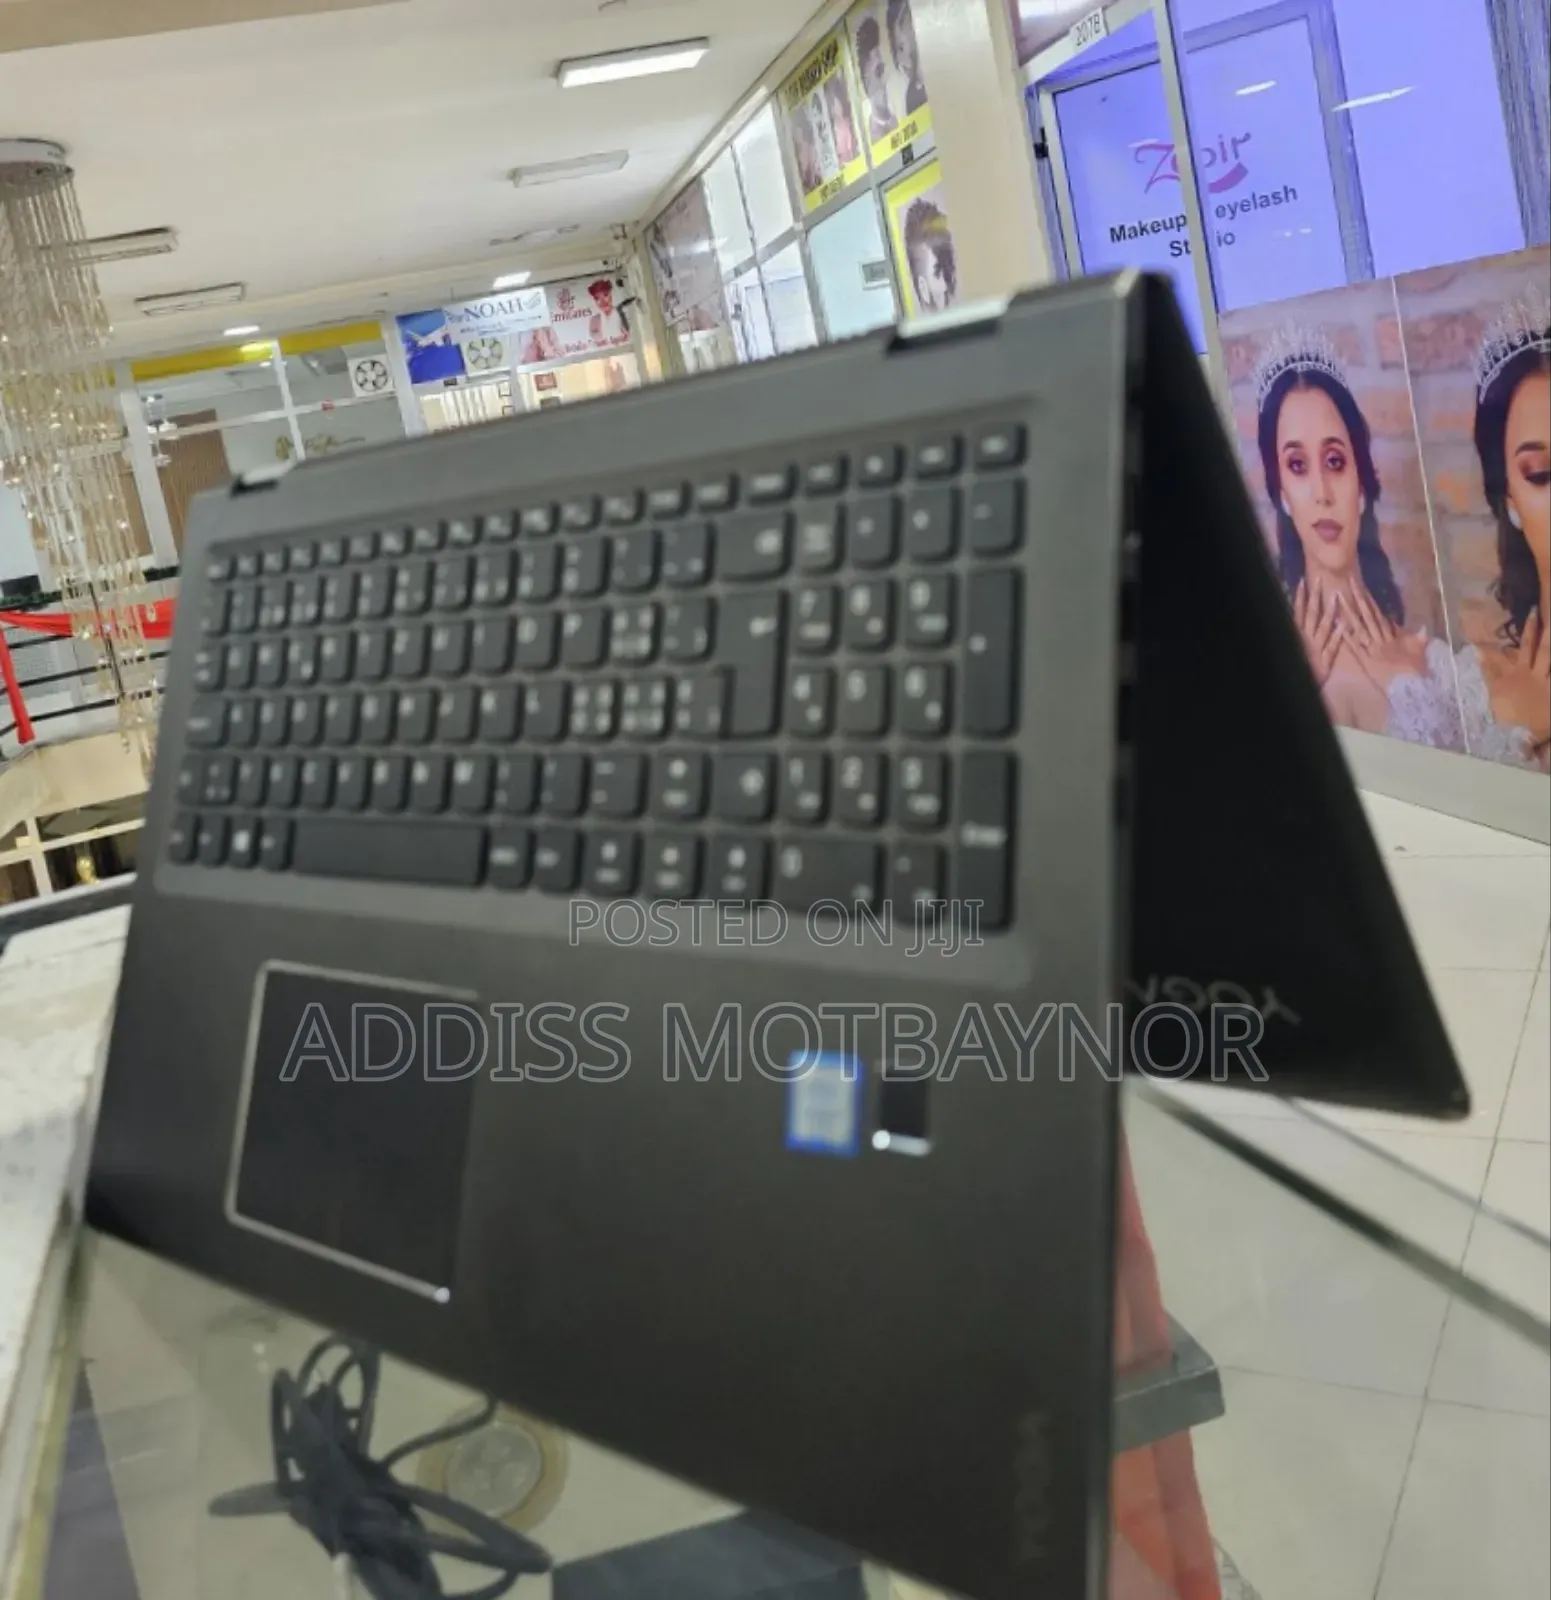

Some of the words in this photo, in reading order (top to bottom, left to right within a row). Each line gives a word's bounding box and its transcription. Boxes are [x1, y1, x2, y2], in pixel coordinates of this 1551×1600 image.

[1109, 213, 1188, 244] Makeup
[1215, 185, 1298, 221] eyelash
[1169, 231, 1235, 258] Stio
[463, 298, 524, 319] NOAH
